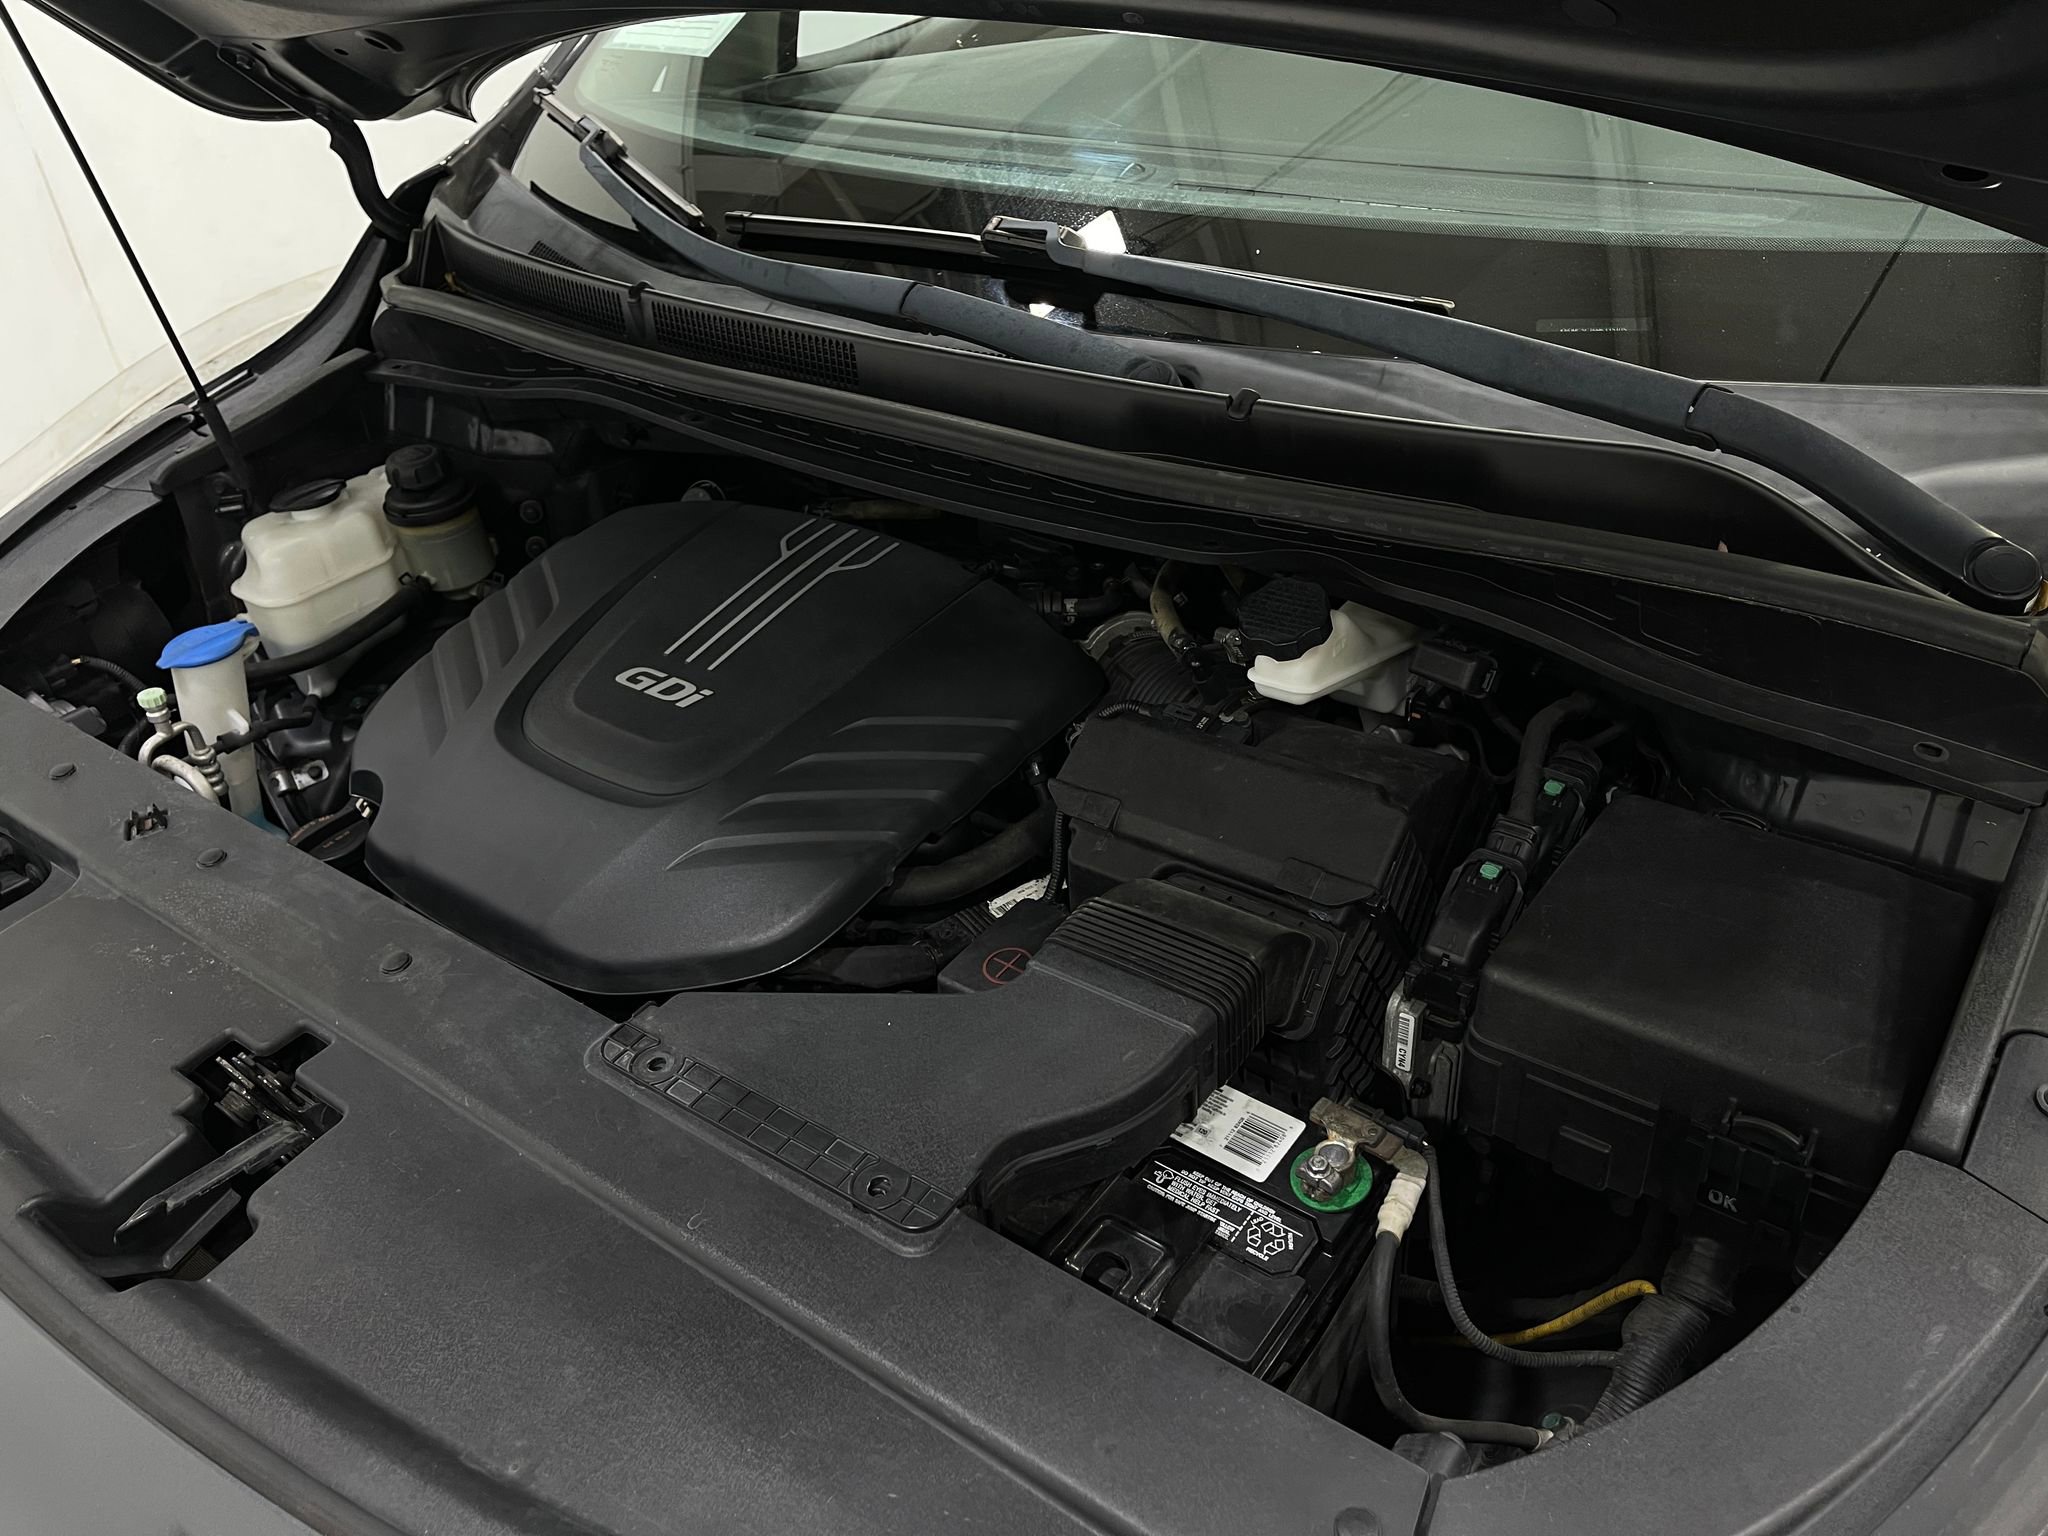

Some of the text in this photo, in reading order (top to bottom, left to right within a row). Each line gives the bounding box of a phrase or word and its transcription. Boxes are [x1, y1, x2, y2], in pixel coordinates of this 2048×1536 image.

[615, 666, 715, 708] GDi
[1398, 1048, 1407, 1068] CYN4
[1170, 1180, 1186, 1190] WITH
[1205, 1197, 1218, 1206] GET
[1174, 1175, 1193, 1188] FLUSH
[1191, 1184, 1207, 1195] EYES
[1167, 1185, 1221, 1215] MEDICAL HELP FAST
[1708, 1188, 1738, 1213] OK
